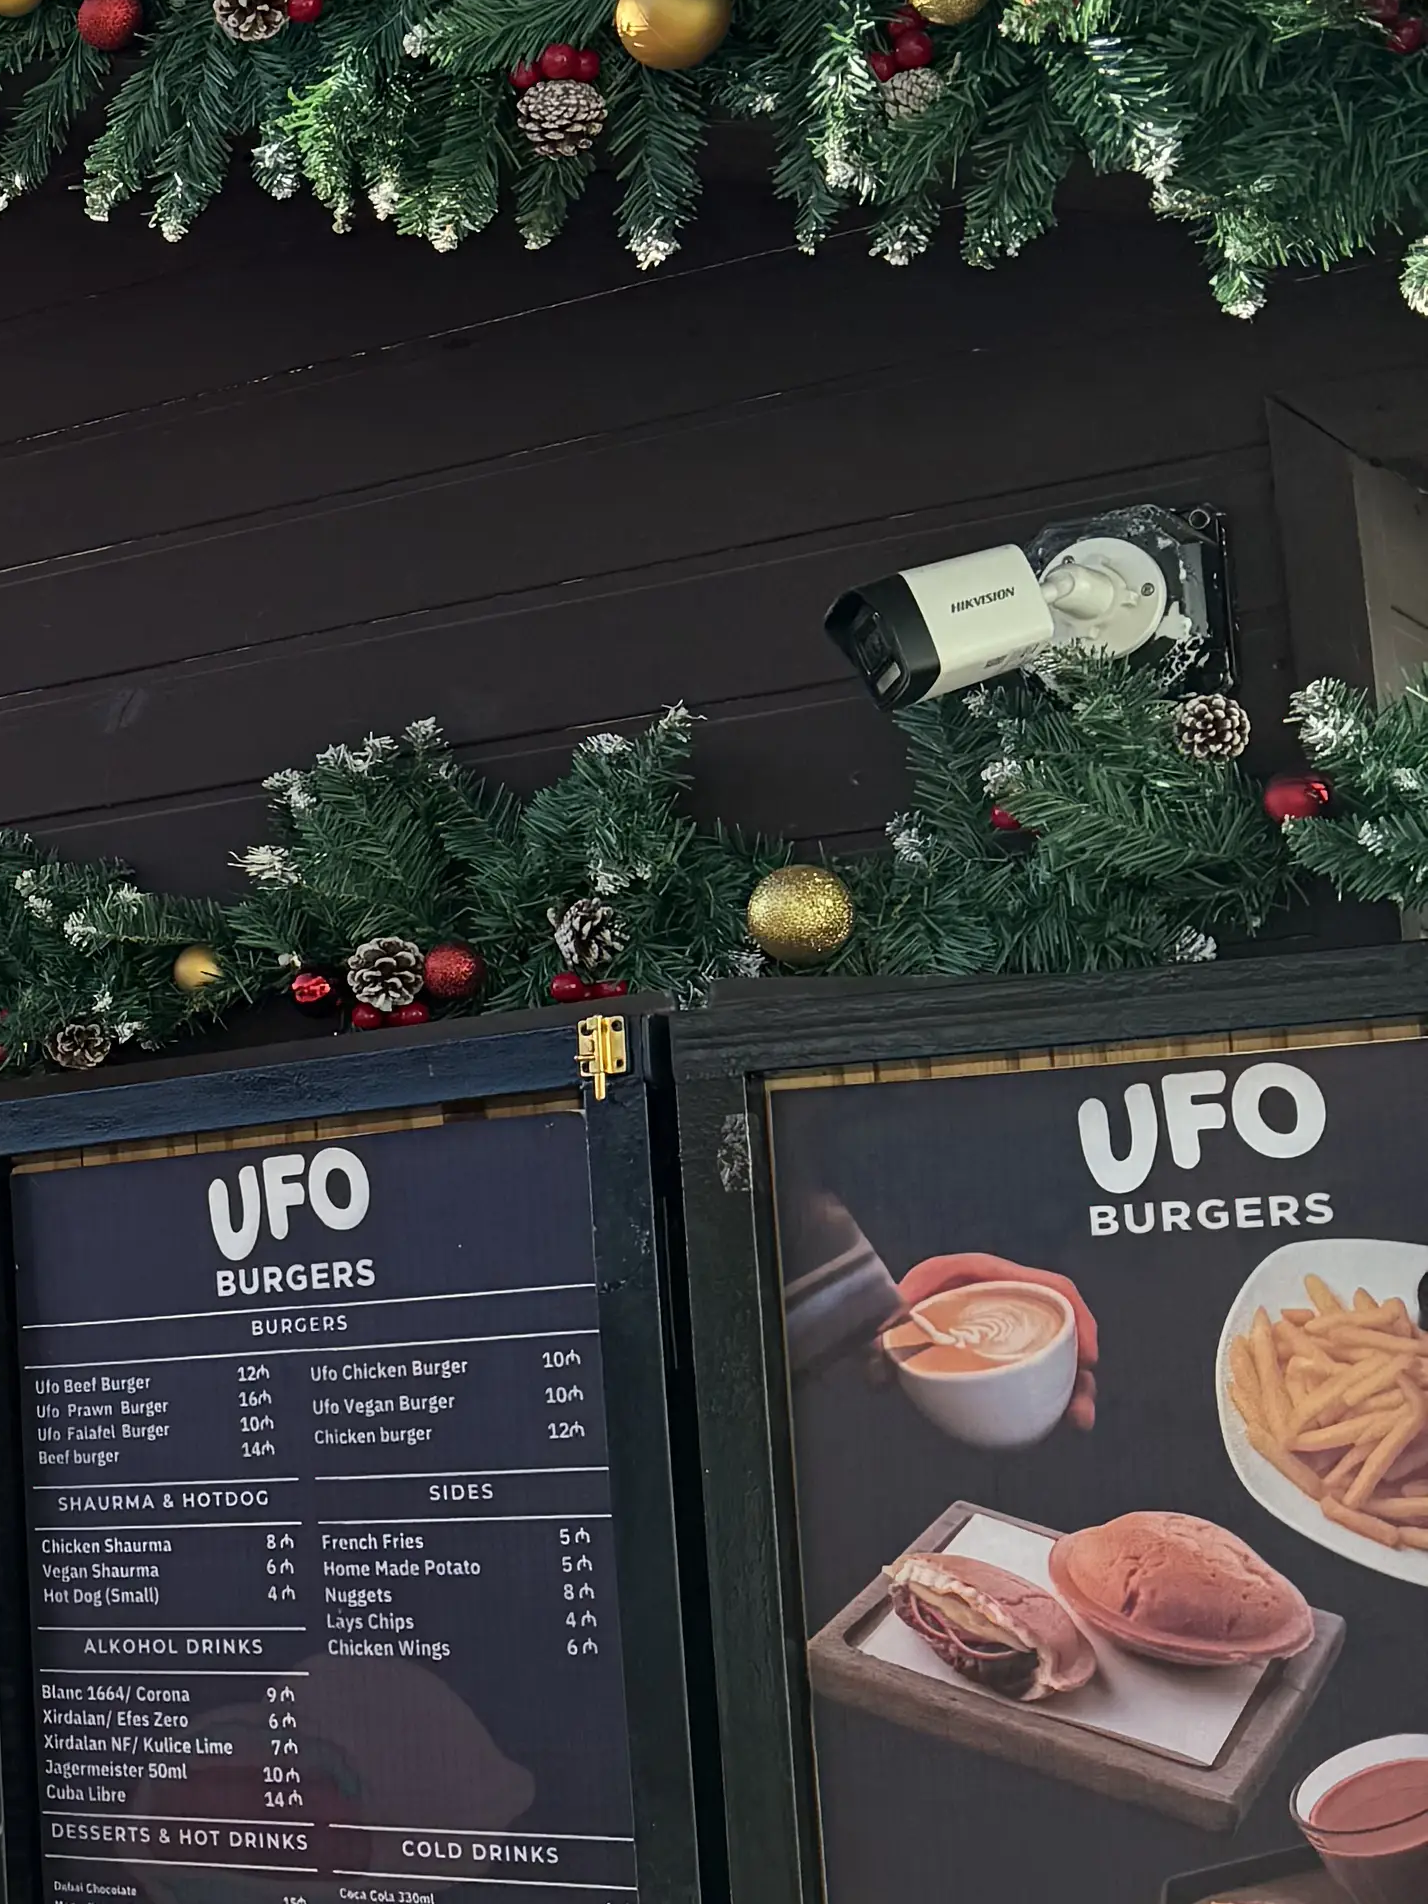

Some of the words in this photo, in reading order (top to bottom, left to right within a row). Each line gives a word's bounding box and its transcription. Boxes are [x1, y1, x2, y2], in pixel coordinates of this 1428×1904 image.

[950, 586, 1015, 613] HIKVISION
[1078, 1062, 1326, 1193] UFO
[208, 1147, 370, 1261] UFO
[1089, 1193, 1335, 1237] BURGERS
[216, 1259, 376, 1297] BURGERS
[251, 1315, 348, 1336] BURGERS
[311, 1365, 337, 1381] Ufo
[342, 1362, 407, 1380] Chicken
[412, 1360, 468, 1378] Burger
[36, 1379, 59, 1394] Ufo
[64, 1377, 96, 1393] Beef
[101, 1377, 150, 1394] Burger
[37, 1404, 59, 1418] Ufo
[68, 1404, 112, 1417] Prawn
[121, 1401, 168, 1417] Burger
[313, 1398, 339, 1415] Ufo
[344, 1399, 394, 1416] Vegan
[399, 1395, 455, 1413] Burger
[38, 1427, 61, 1441] Ufo
[68, 1424, 115, 1440] Falafel
[122, 1424, 170, 1441] Burger
[315, 1429, 375, 1444] Chicken
[380, 1427, 432, 1445] burger
[39, 1450, 69, 1464] Beef
[73, 1449, 119, 1467] burger
[58, 1494, 154, 1511] SHAURMA
[163, 1493, 174, 1508] &
[183, 1490, 268, 1507] HOTDOG
[429, 1483, 493, 1501] SIDES
[42, 1539, 100, 1553] Chicken
[104, 1537, 172, 1553] Shaurma
[322, 1533, 378, 1550] French
[383, 1532, 424, 1549] Fries
[42, 1564, 88, 1581] Vegan
[92, 1563, 159, 1578] Shaurma
[324, 1561, 370, 1576] Home
[375, 1559, 419, 1576] Made
[425, 1560, 480, 1575] Potato
[44, 1588, 69, 1603] Hot
[74, 1589, 102, 1606] Dog
[105, 1587, 159, 1605] (Small)
[325, 1587, 392, 1606] Nuggets
[327, 1614, 363, 1631] Lays
[368, 1612, 414, 1632] Chips
[84, 1638, 178, 1654] ALKOHOL
[187, 1639, 262, 1654] DRINKS
[328, 1639, 394, 1656] Chicken
[398, 1639, 450, 1659] Wings
[42, 1684, 83, 1700] Blanc
[136, 1686, 190, 1702] Corona
[117, 1710, 149, 1727] Efes
[154, 1712, 188, 1727] Zero
[44, 1734, 106, 1750] Xirdalan
[143, 1737, 191, 1753] Kulice
[196, 1737, 233, 1755] Lime
[46, 1760, 144, 1779] Jagermeister
[148, 1763, 187, 1779] 50ml
[47, 1784, 84, 1801] Cuba
[88, 1786, 126, 1802] Libre
[52, 1823, 150, 1842] DESSERTS
[159, 1828, 170, 1843] &
[179, 1829, 220, 1846] HOT
[229, 1831, 307, 1850] DRINKS
[402, 1840, 462, 1859] COLD
[472, 1844, 558, 1863] DRINKS
